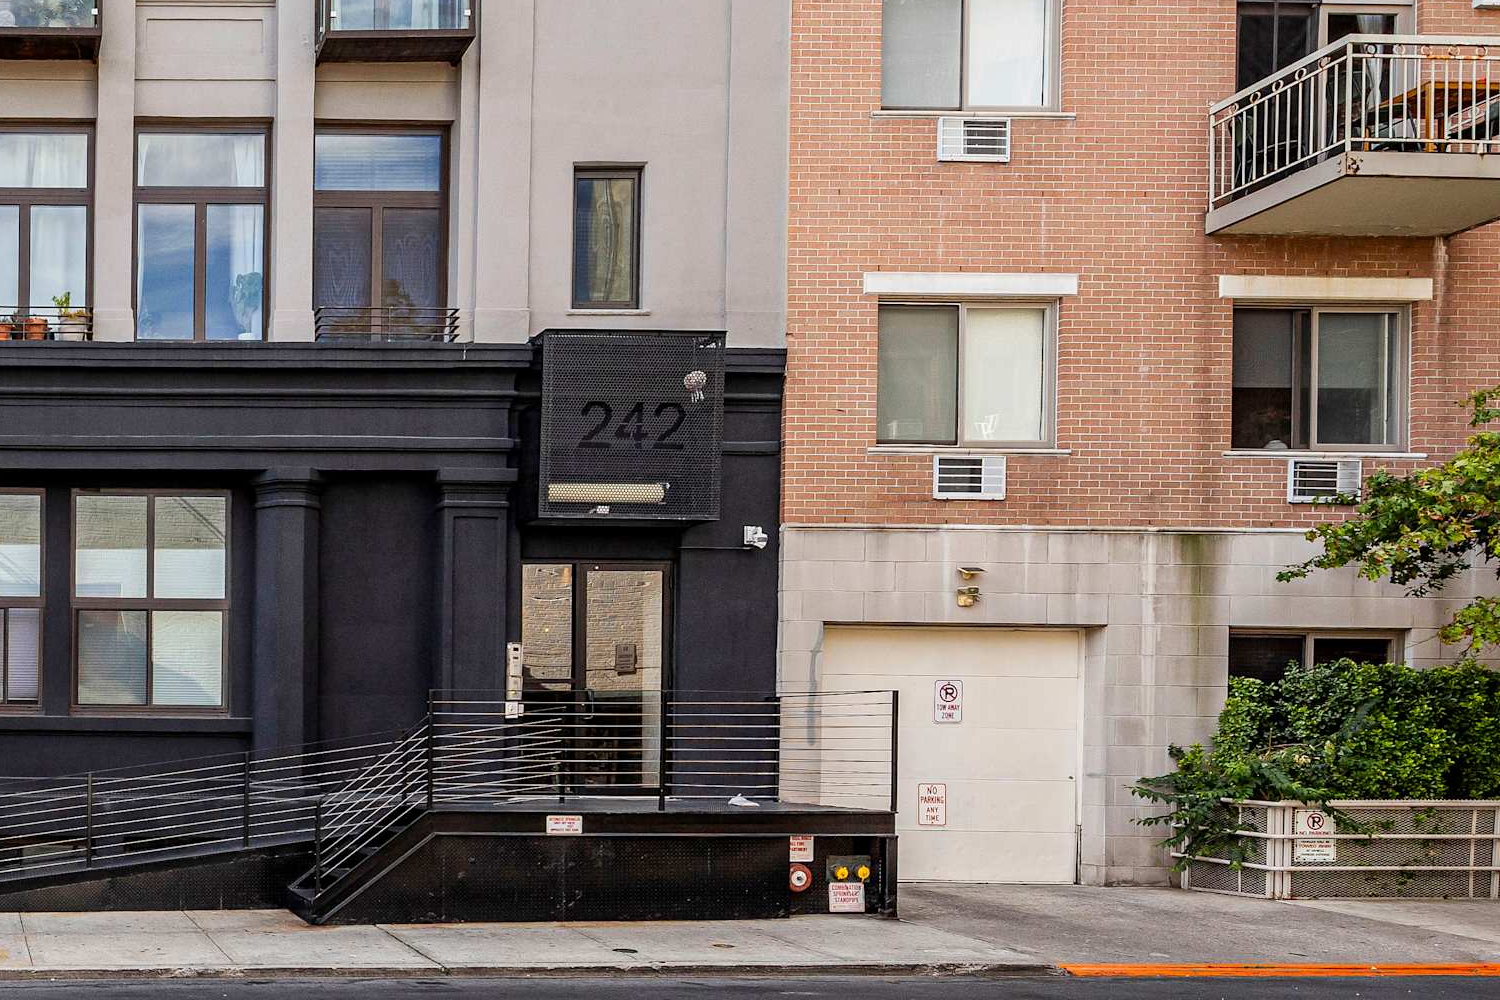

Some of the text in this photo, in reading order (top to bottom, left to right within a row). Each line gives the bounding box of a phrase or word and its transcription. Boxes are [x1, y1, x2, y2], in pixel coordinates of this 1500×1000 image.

[578, 400, 687, 450] 242
[936, 703, 961, 711] TOW AWAY
[927, 786, 938, 795] NO
[920, 796, 944, 804] PARKING
[925, 814, 940, 822] TIME
